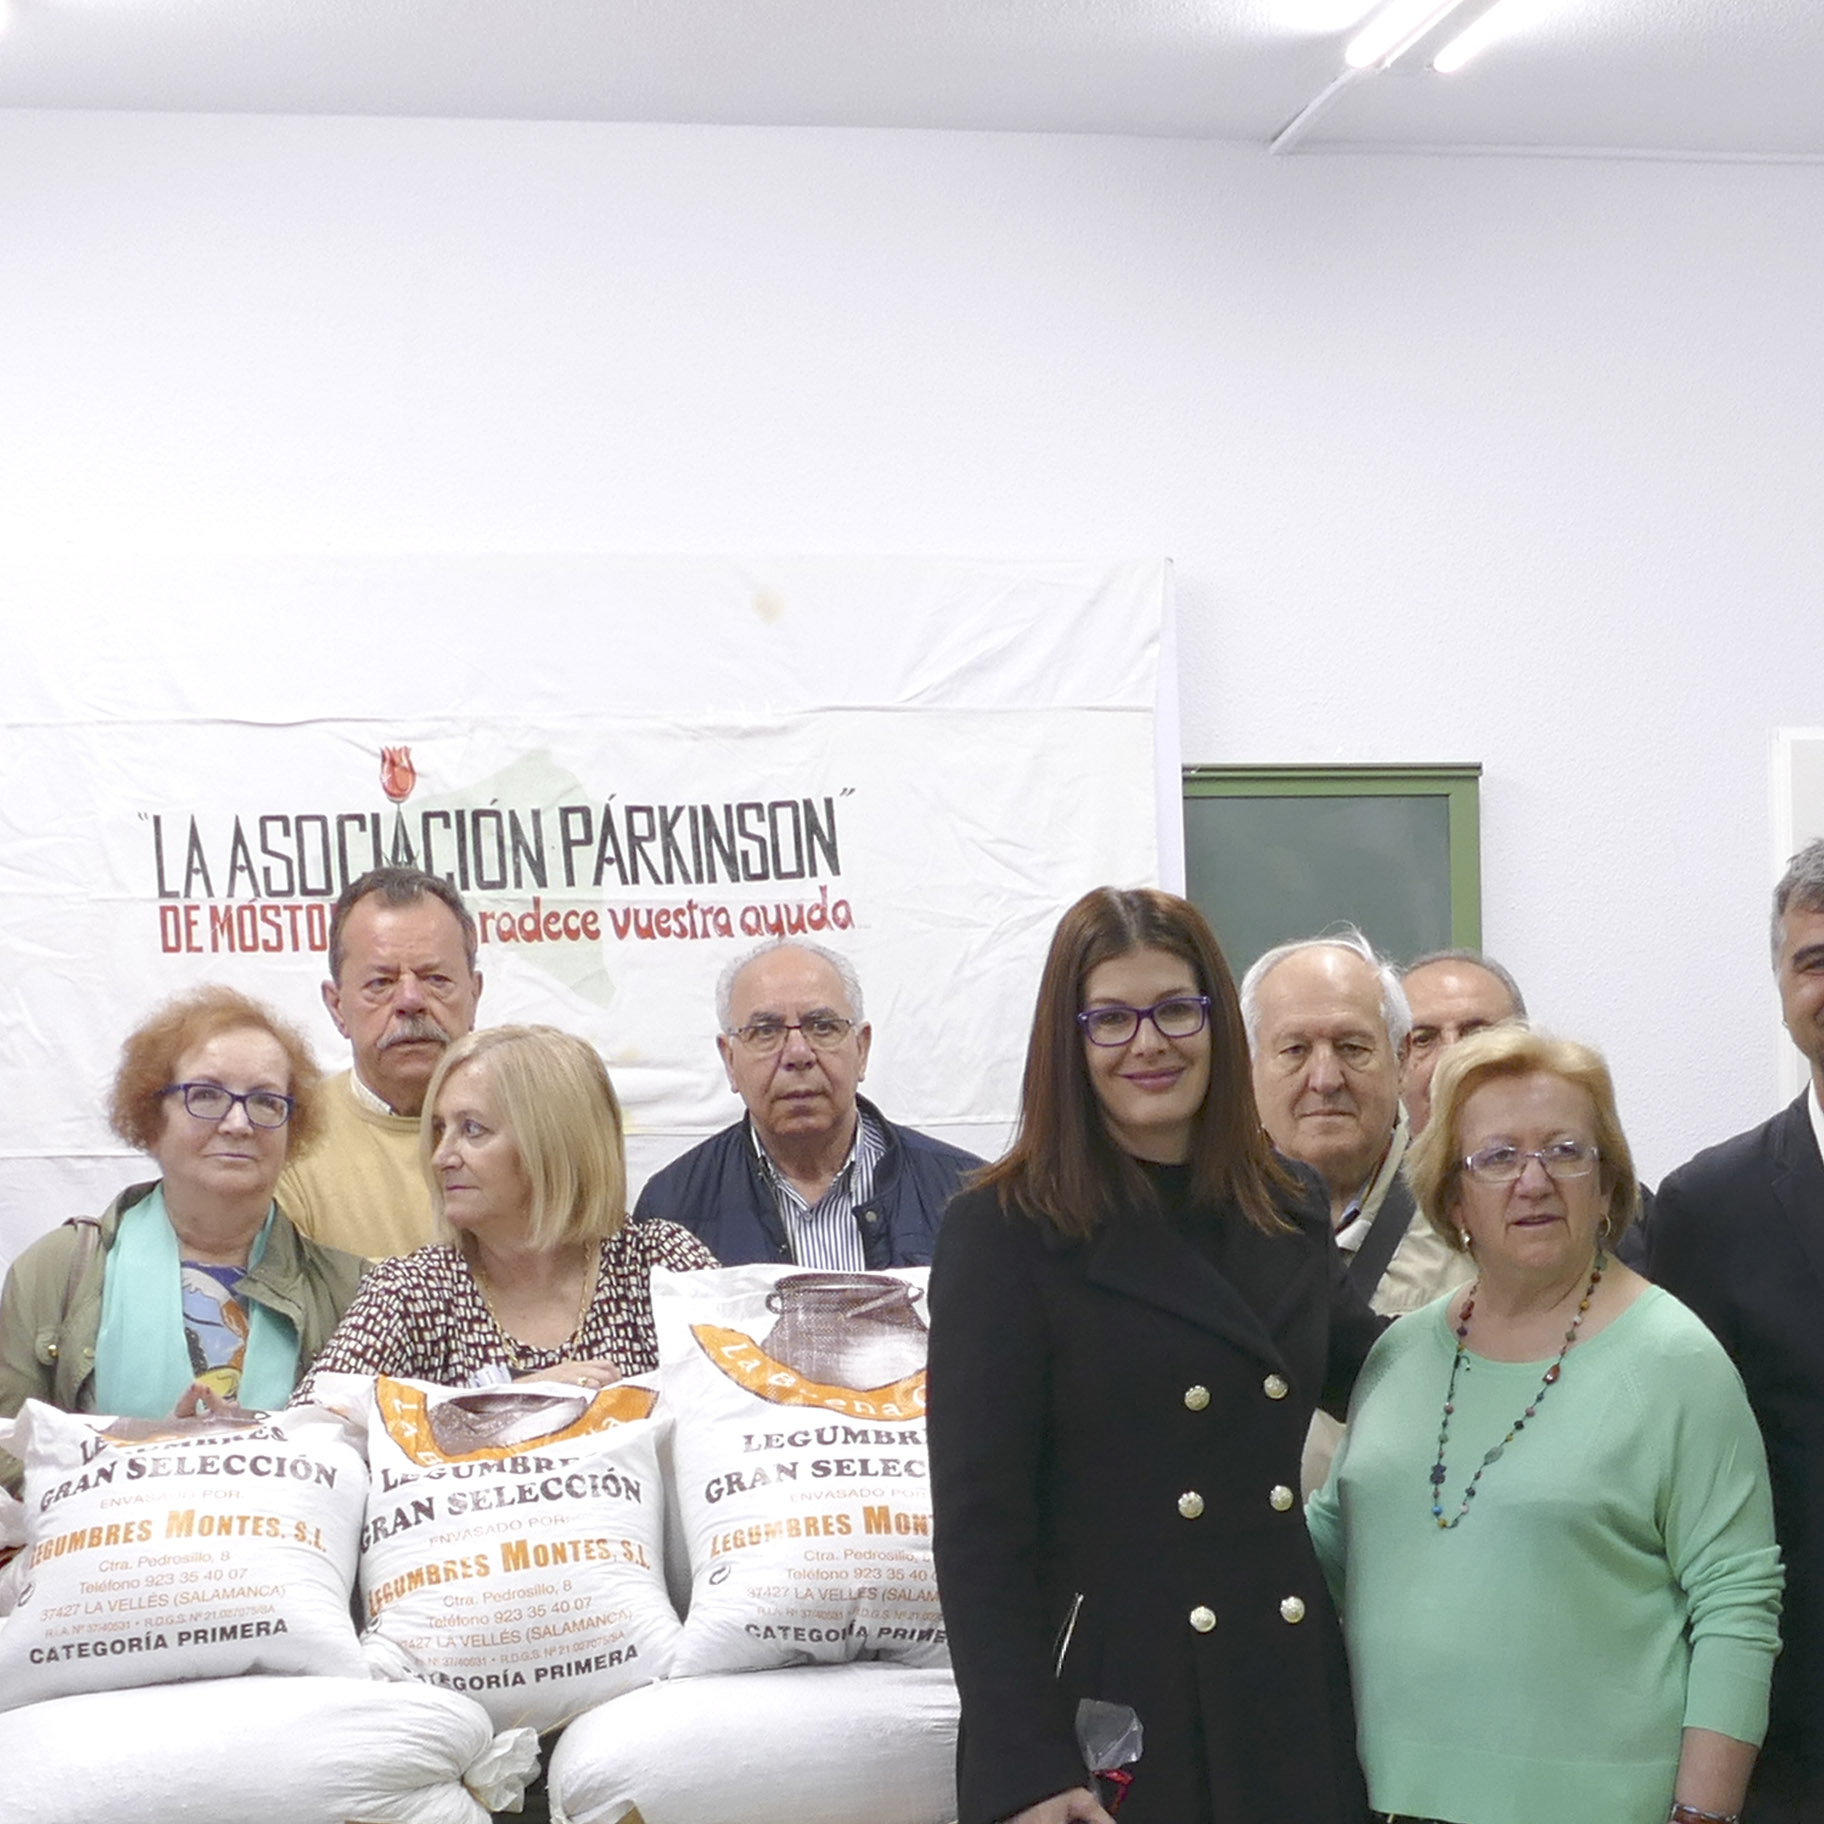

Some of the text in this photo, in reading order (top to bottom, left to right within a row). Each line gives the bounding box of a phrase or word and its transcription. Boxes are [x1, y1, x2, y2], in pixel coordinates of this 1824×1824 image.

[227, 798, 548, 898] ASOCIACIÓN
[159, 886, 856, 953] DE MÓSTO radece vuestra ayuda
[743, 1425, 927, 1453] LEGUMBR
[40, 1454, 337, 1511] GRAN SELECCIÓN
[705, 1459, 926, 1504] GRAN SELEC
[360, 1467, 642, 1552] GRAN SELECCIÓN
[28, 1519, 152, 1569] LEGUMBRES
[711, 1514, 852, 1558] LEGUMBRES
[804, 1550, 838, 1561] Ctra.
[145, 1573, 174, 1587] 923
[180, 1570, 199, 1583] 35
[204, 1569, 223, 1582] 40
[229, 1568, 248, 1580] 07
[368, 1554, 490, 1617] LEGUMBRES
[787, 1568, 848, 1580] Teléfono
[854, 1568, 882, 1580] 923
[887, 1569, 905, 1580] 35
[910, 1570, 927, 1581] 40
[794, 1587, 814, 1599] LA
[84, 1600, 103, 1615] LA
[173, 1585, 285, 1608] (SALAMANCA)
[494, 1609, 523, 1624] 923
[528, 1606, 546, 1619] 35
[551, 1601, 570, 1613] 40
[574, 1597, 593, 1610] 07
[30, 1618, 288, 1664] CATEGORÍA PRIMERA
[436, 1637, 456, 1649] LA
[460, 1628, 521, 1648] VELLÉS
[526, 1609, 632, 1644] (SALAMANCA)
[878, 1627, 947, 1643] PRIME
[535, 1644, 638, 1683] PRIMERA
